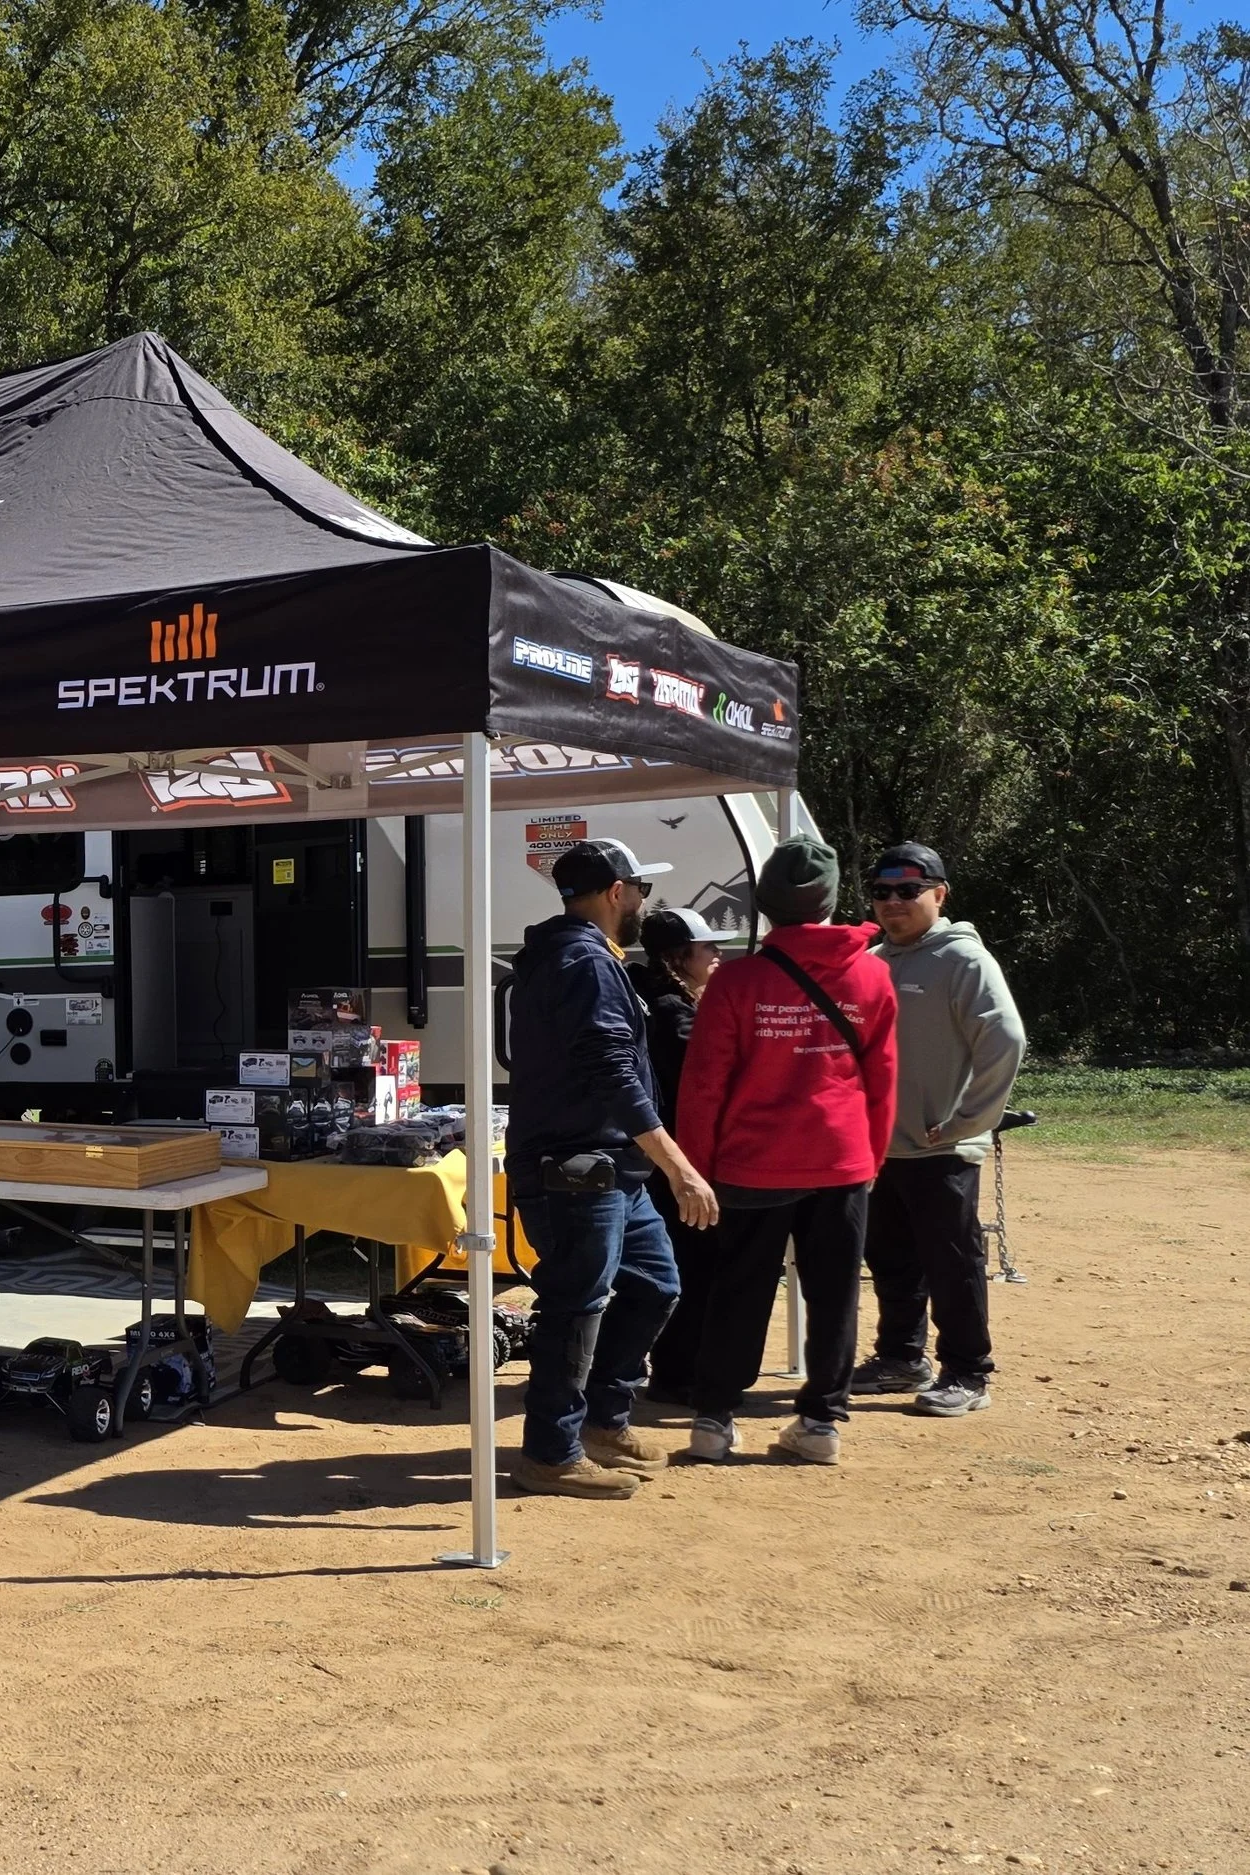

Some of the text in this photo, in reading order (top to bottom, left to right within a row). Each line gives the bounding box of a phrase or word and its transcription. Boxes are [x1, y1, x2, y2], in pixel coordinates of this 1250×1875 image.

[57, 662, 315, 709] SPEKTRUM
[530, 815, 581, 823] LIMITED
[755, 1003, 777, 1012] Dear
[778, 1004, 810, 1014] person
[770, 1015, 798, 1024] world
[774, 1029, 793, 1039] you
